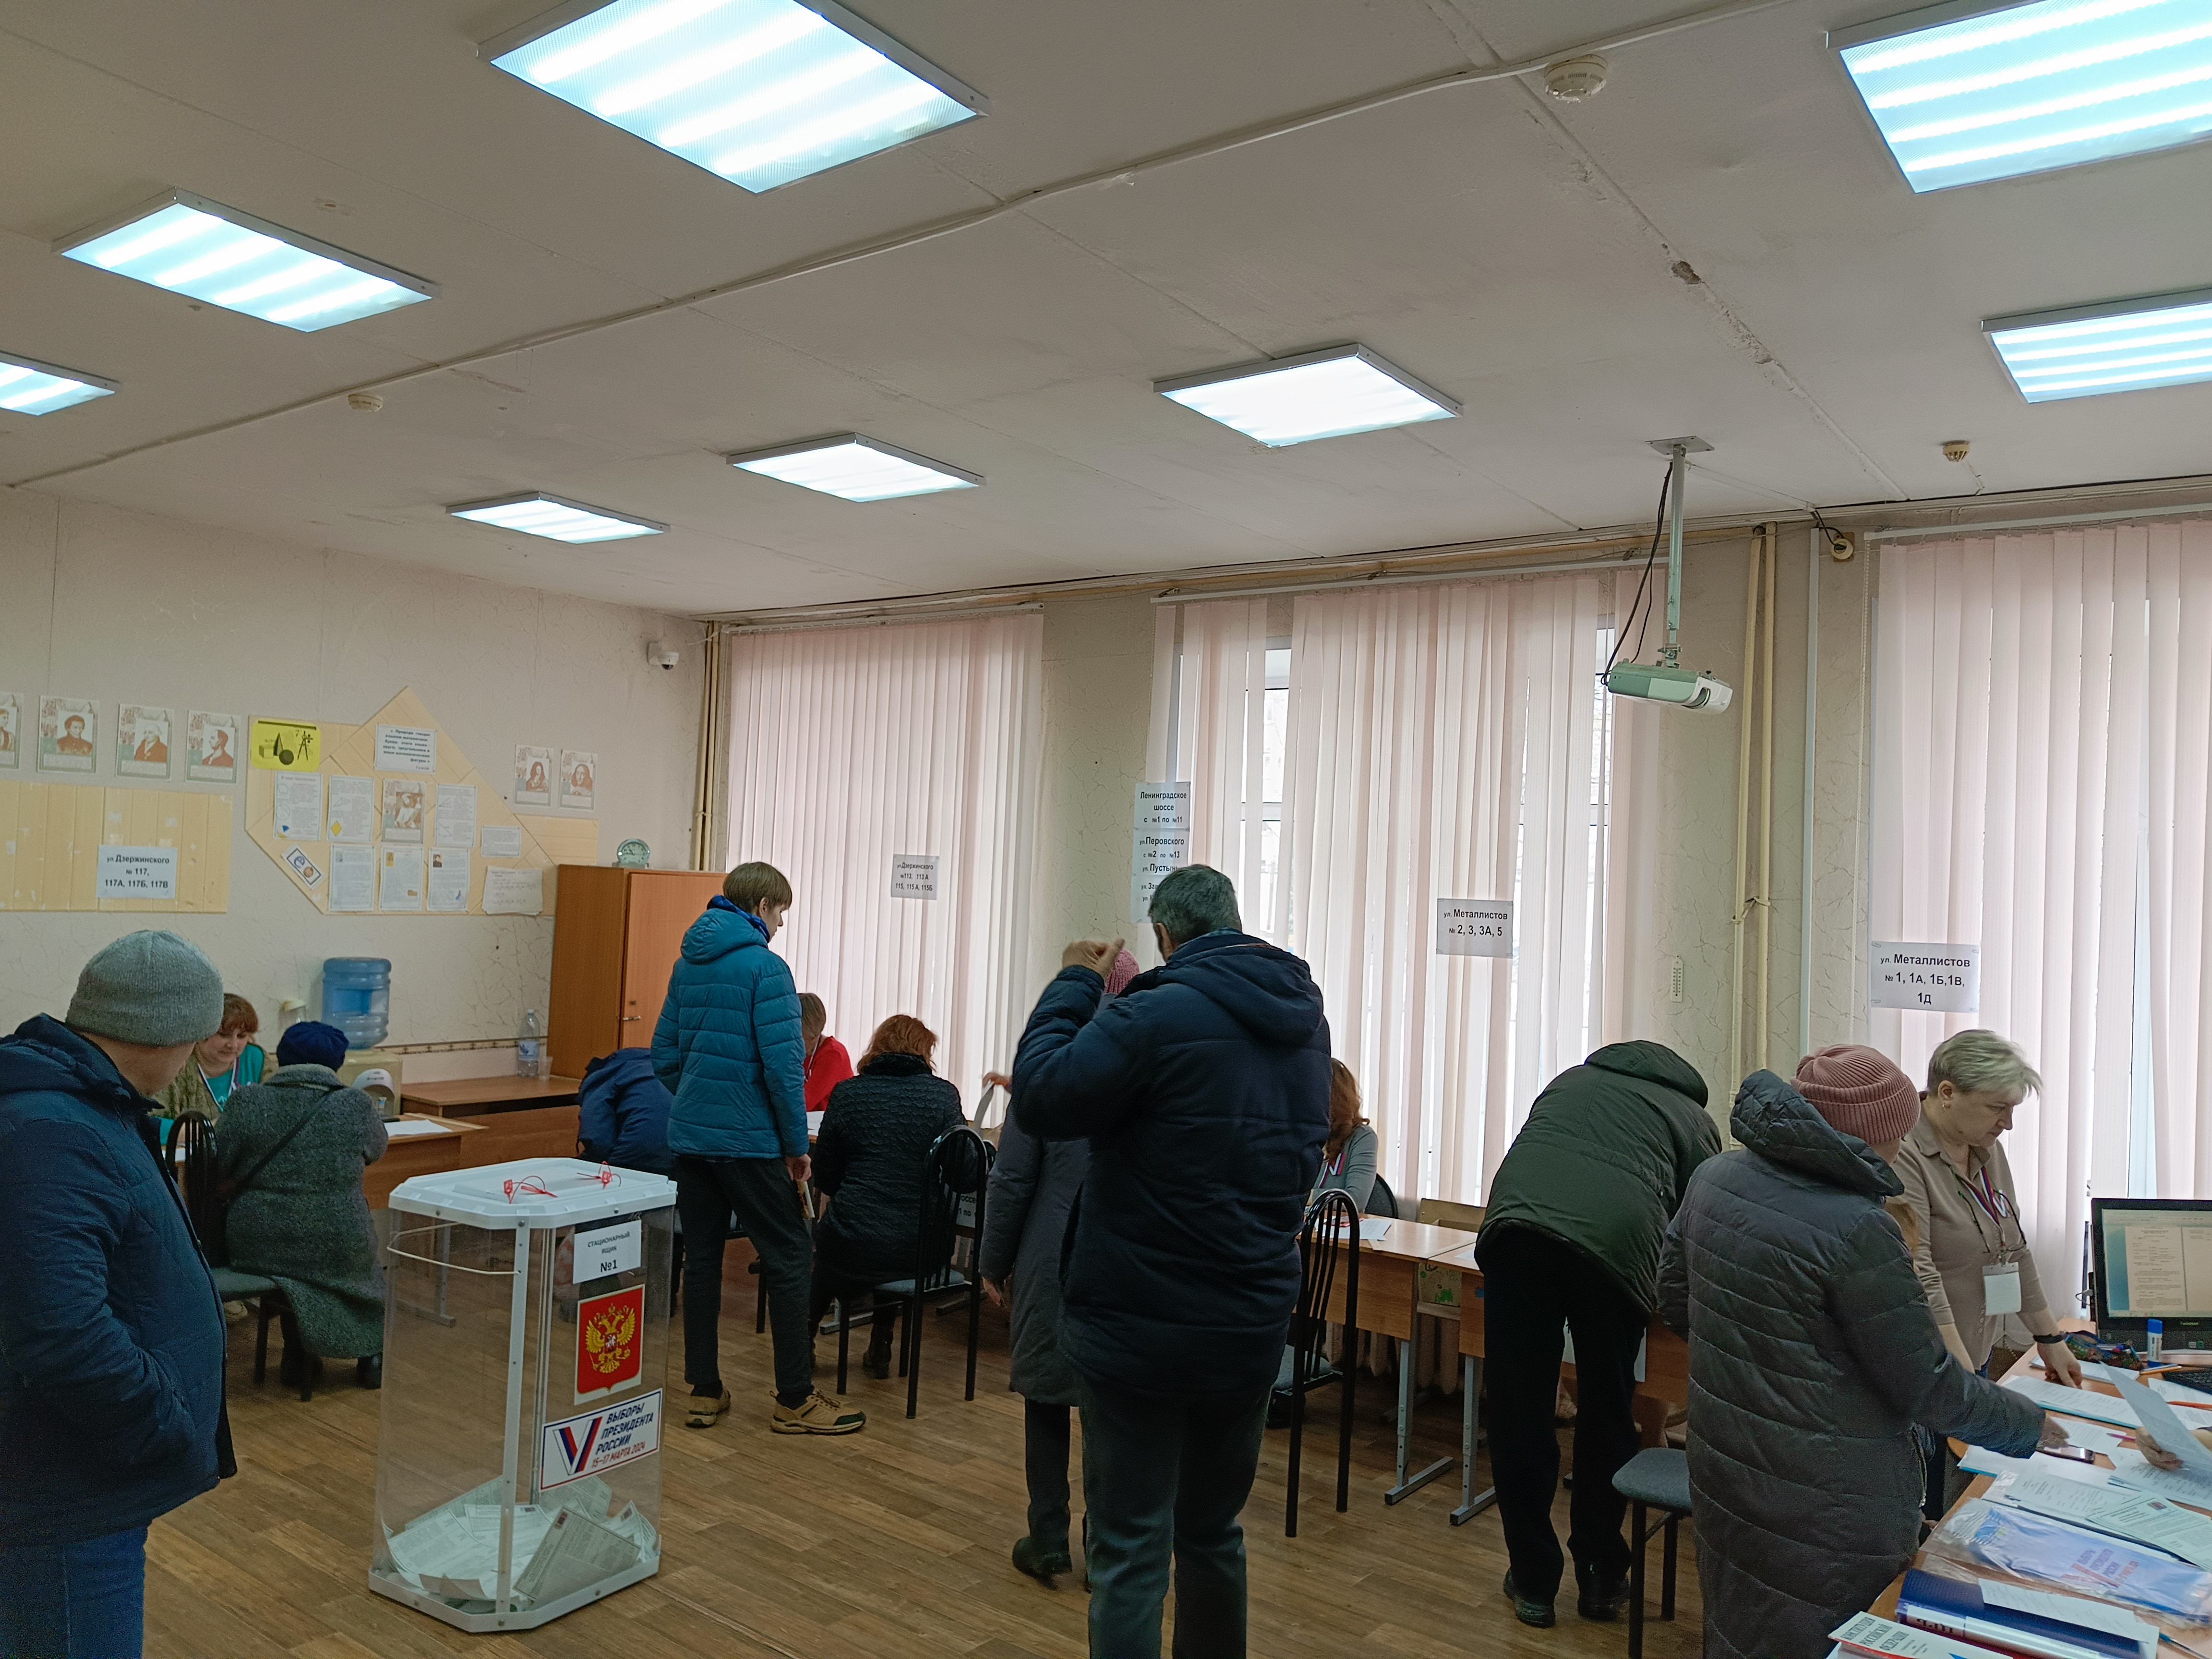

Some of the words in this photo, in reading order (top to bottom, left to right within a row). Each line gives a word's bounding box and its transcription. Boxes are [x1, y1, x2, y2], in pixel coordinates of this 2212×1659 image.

[1140, 792, 1187, 800] Ленинградское
[115, 854, 169, 864] Дзержинского
[1454, 909, 1508, 920] Металлистов
[1457, 924, 1466, 936] 2,
[1468, 925, 1477, 937] 3,
[1479, 926, 1494, 938] 3А,
[1497, 926, 1503, 936] 5
[1894, 954, 1971, 967] Металлистов
[1896, 972, 1905, 984] 1,
[1909, 973, 1926, 985] 1А,
[1918, 992, 1932, 1005] 1Д
[961, 1195, 976, 1203] оссе
[588, 1231, 630, 1248] СТАЦИОНАРНЫЙ
[601, 1246, 617, 1254] ЯЩИК
[601, 1259, 617, 1273] №1
[606, 1402, 645, 1425] ВЫБОРЫ
[601, 1412, 654, 1440] ПРЕЗИДЕНТА
[595, 1433, 632, 1455] РОССИИ
[610, 1446, 631, 1462] МАРТА
[631, 1441, 646, 1454] 2024
